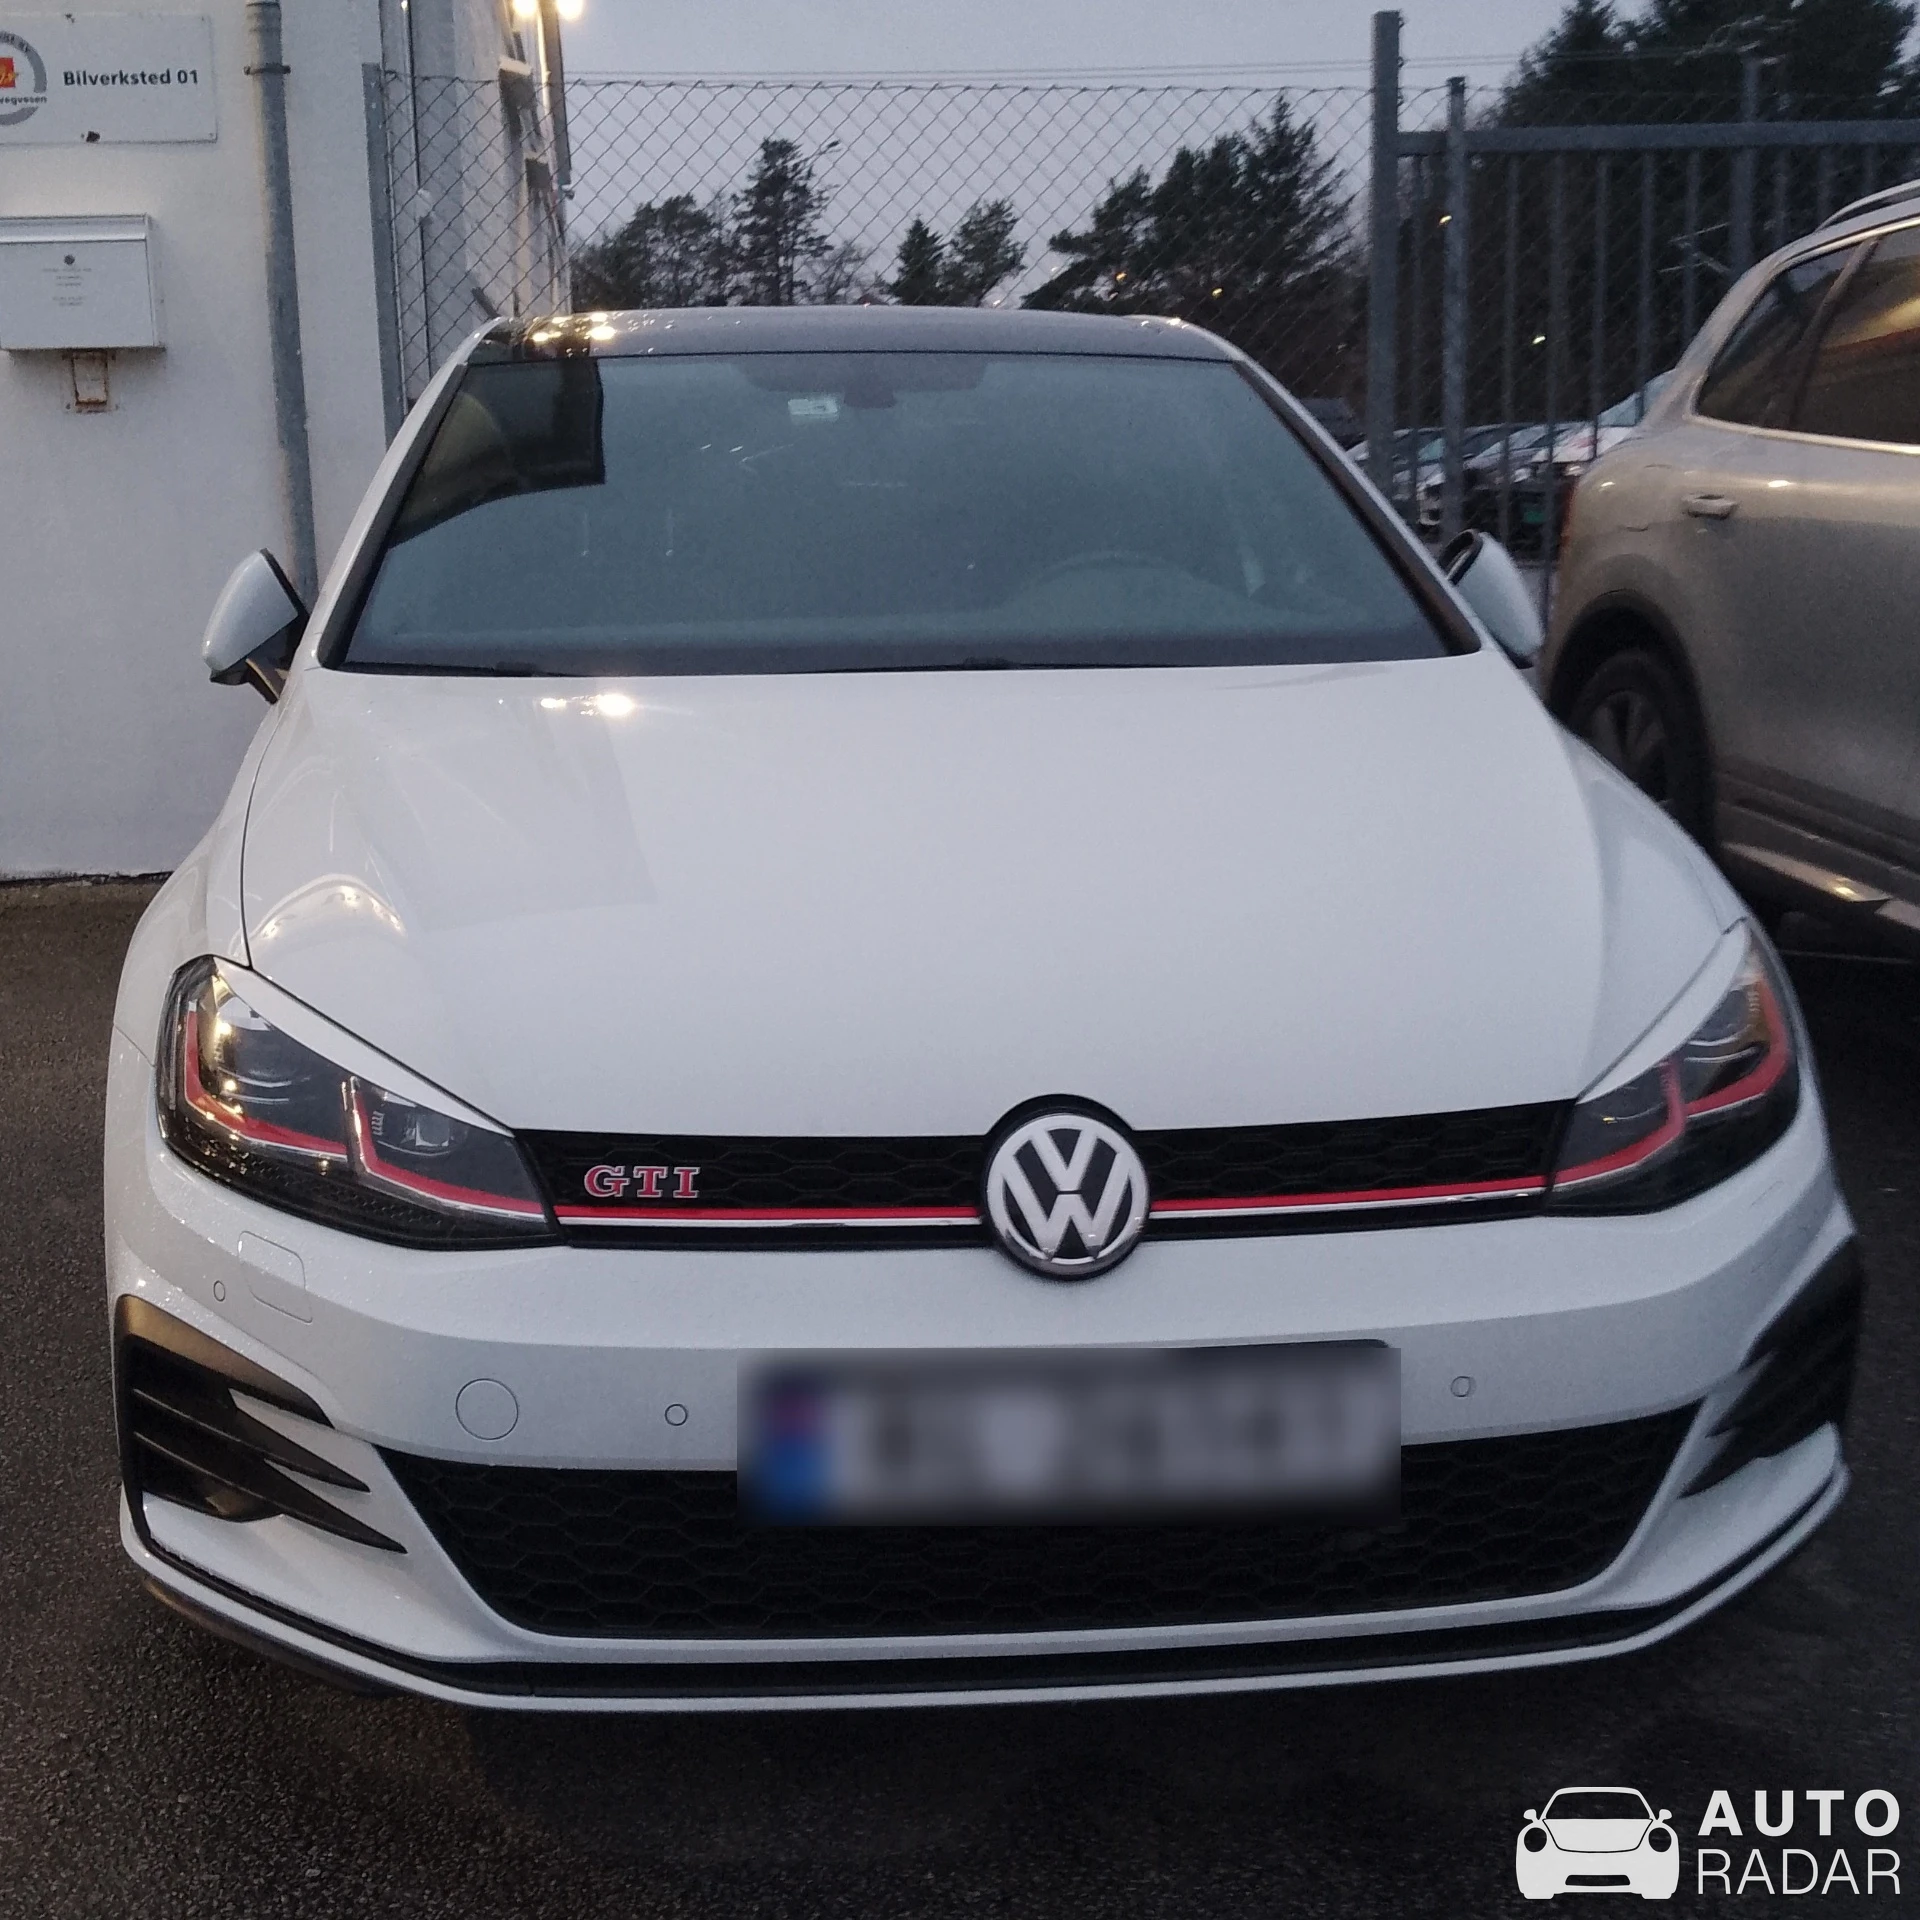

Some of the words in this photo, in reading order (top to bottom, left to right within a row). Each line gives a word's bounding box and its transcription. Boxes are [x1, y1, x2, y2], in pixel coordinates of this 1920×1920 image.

[63, 68, 171, 86] Bilverksted
[177, 69, 198, 84] 01
[584, 1165, 700, 1198] GTI
